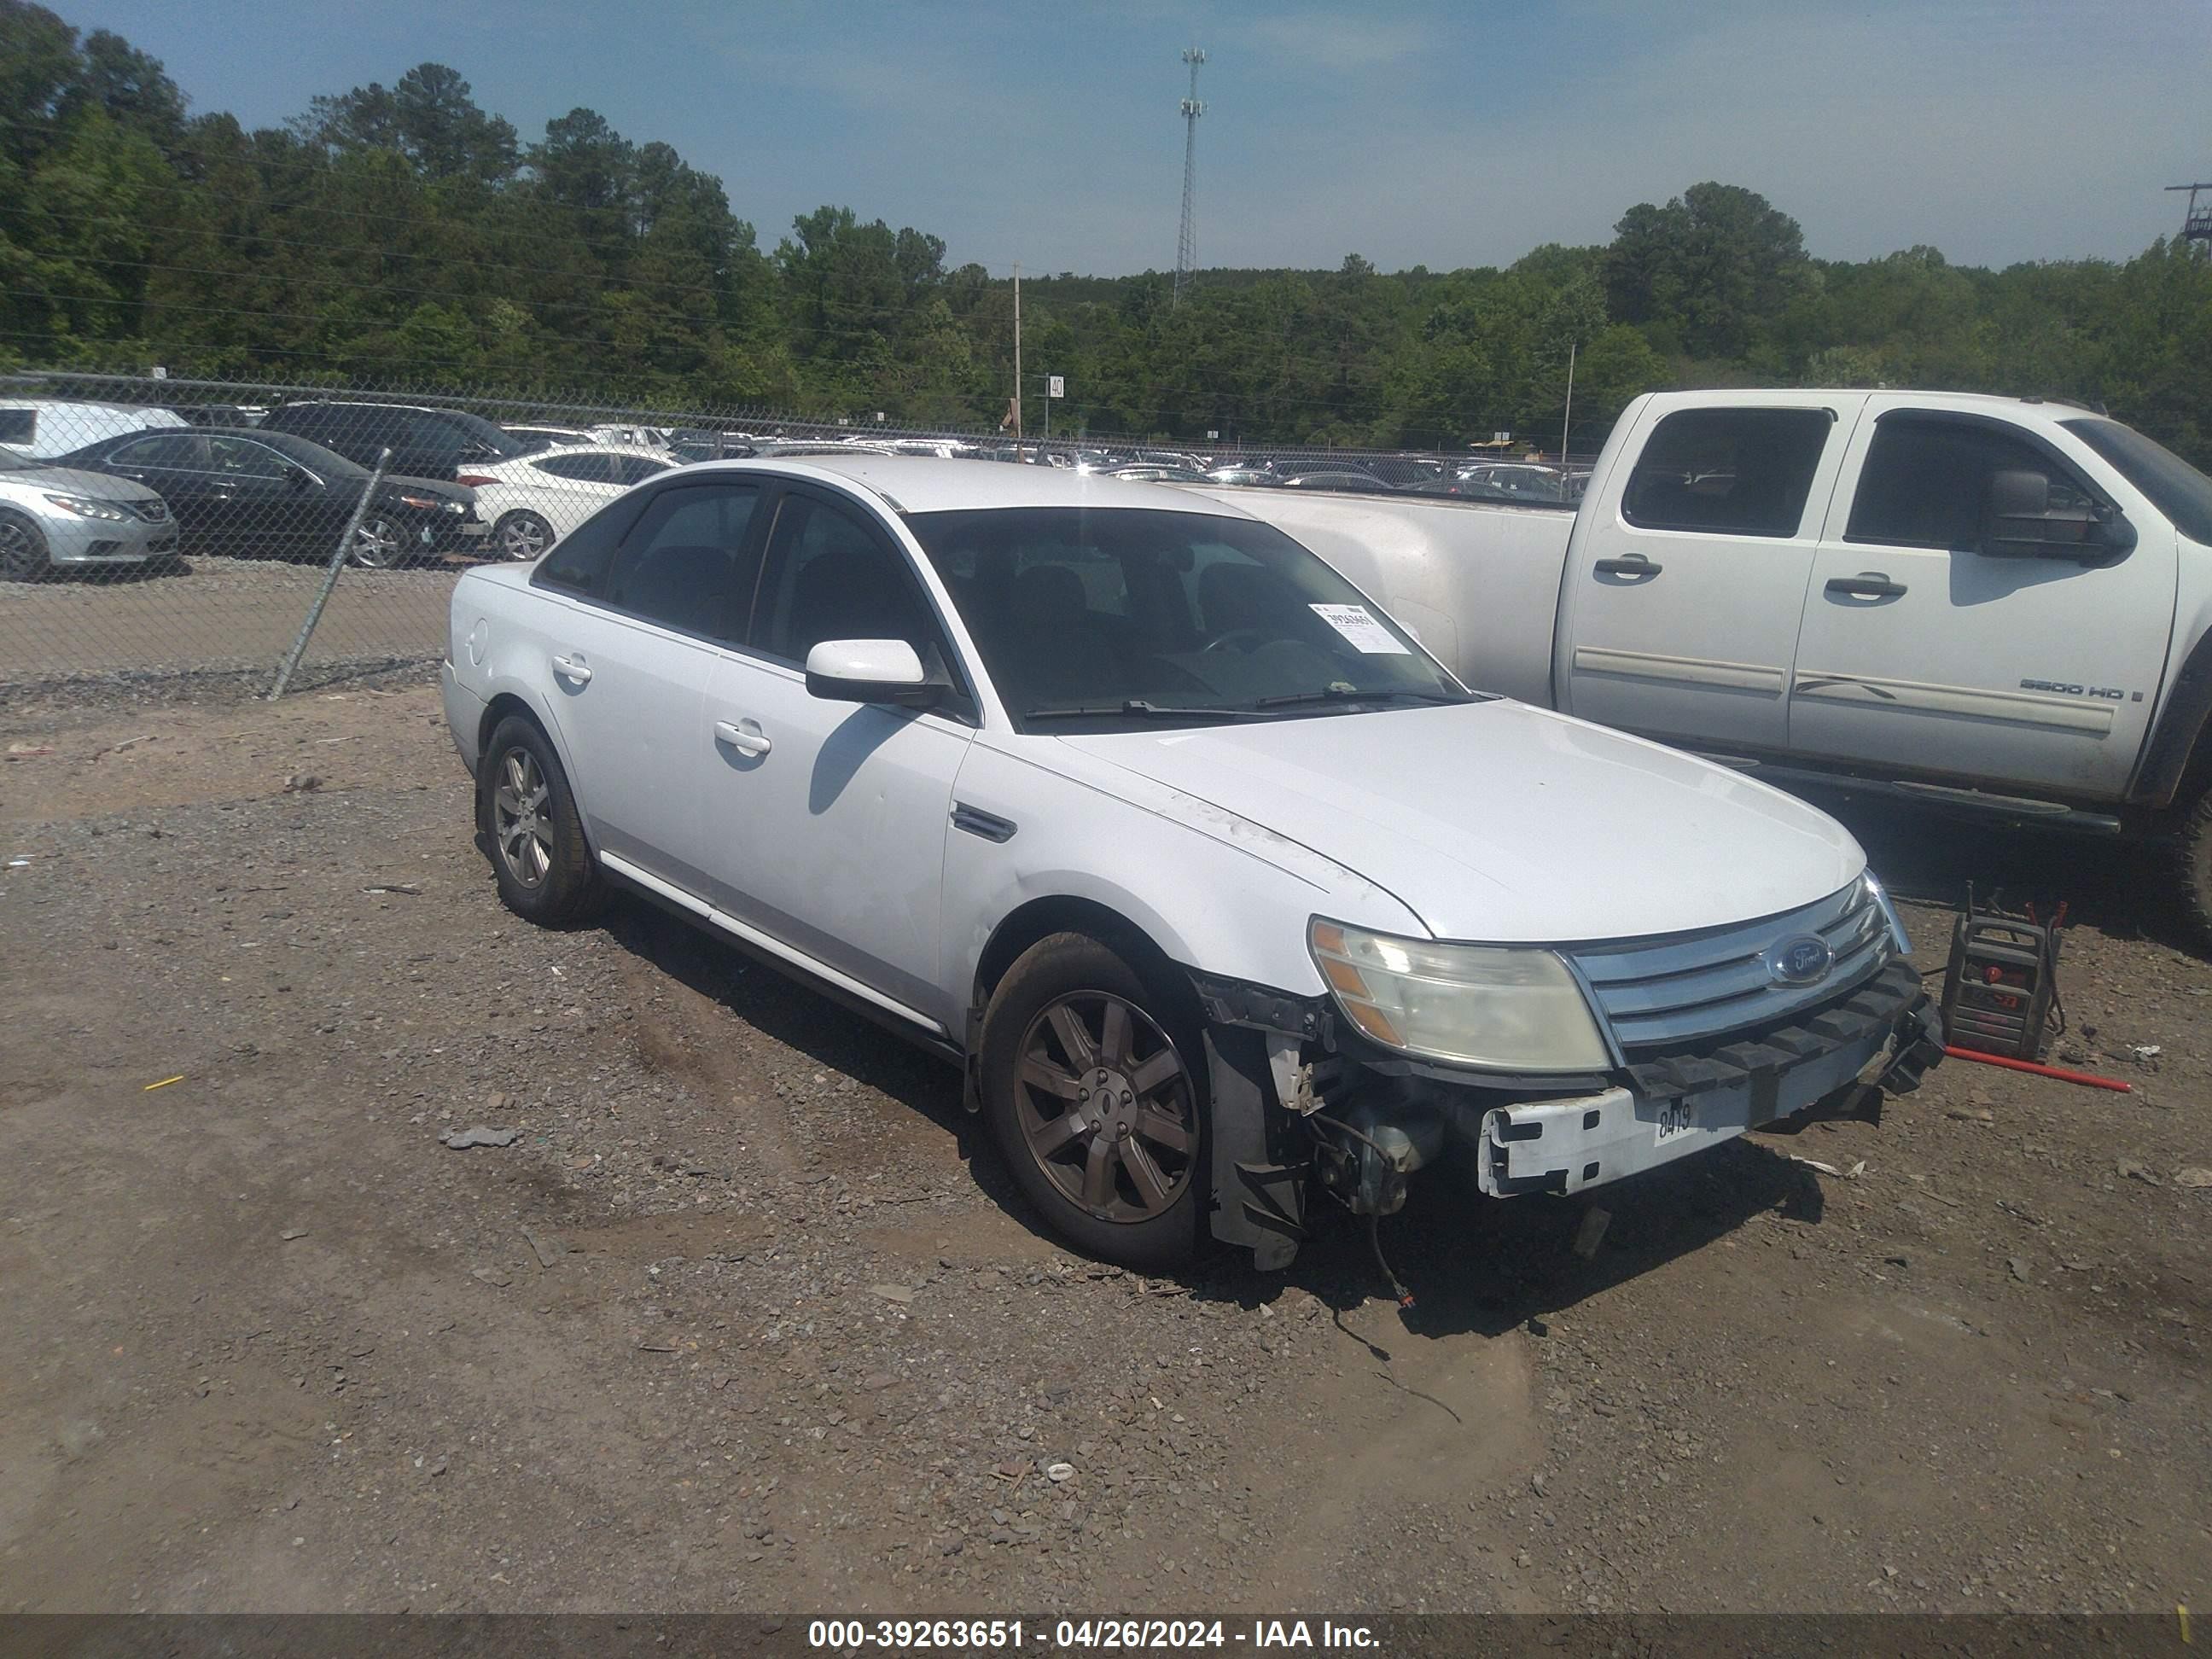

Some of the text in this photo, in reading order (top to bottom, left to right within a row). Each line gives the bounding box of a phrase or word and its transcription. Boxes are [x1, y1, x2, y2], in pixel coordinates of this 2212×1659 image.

[1052, 379, 1062, 396] 40
[2088, 686, 2125, 700] HD
[1794, 947, 1820, 970] Ford
